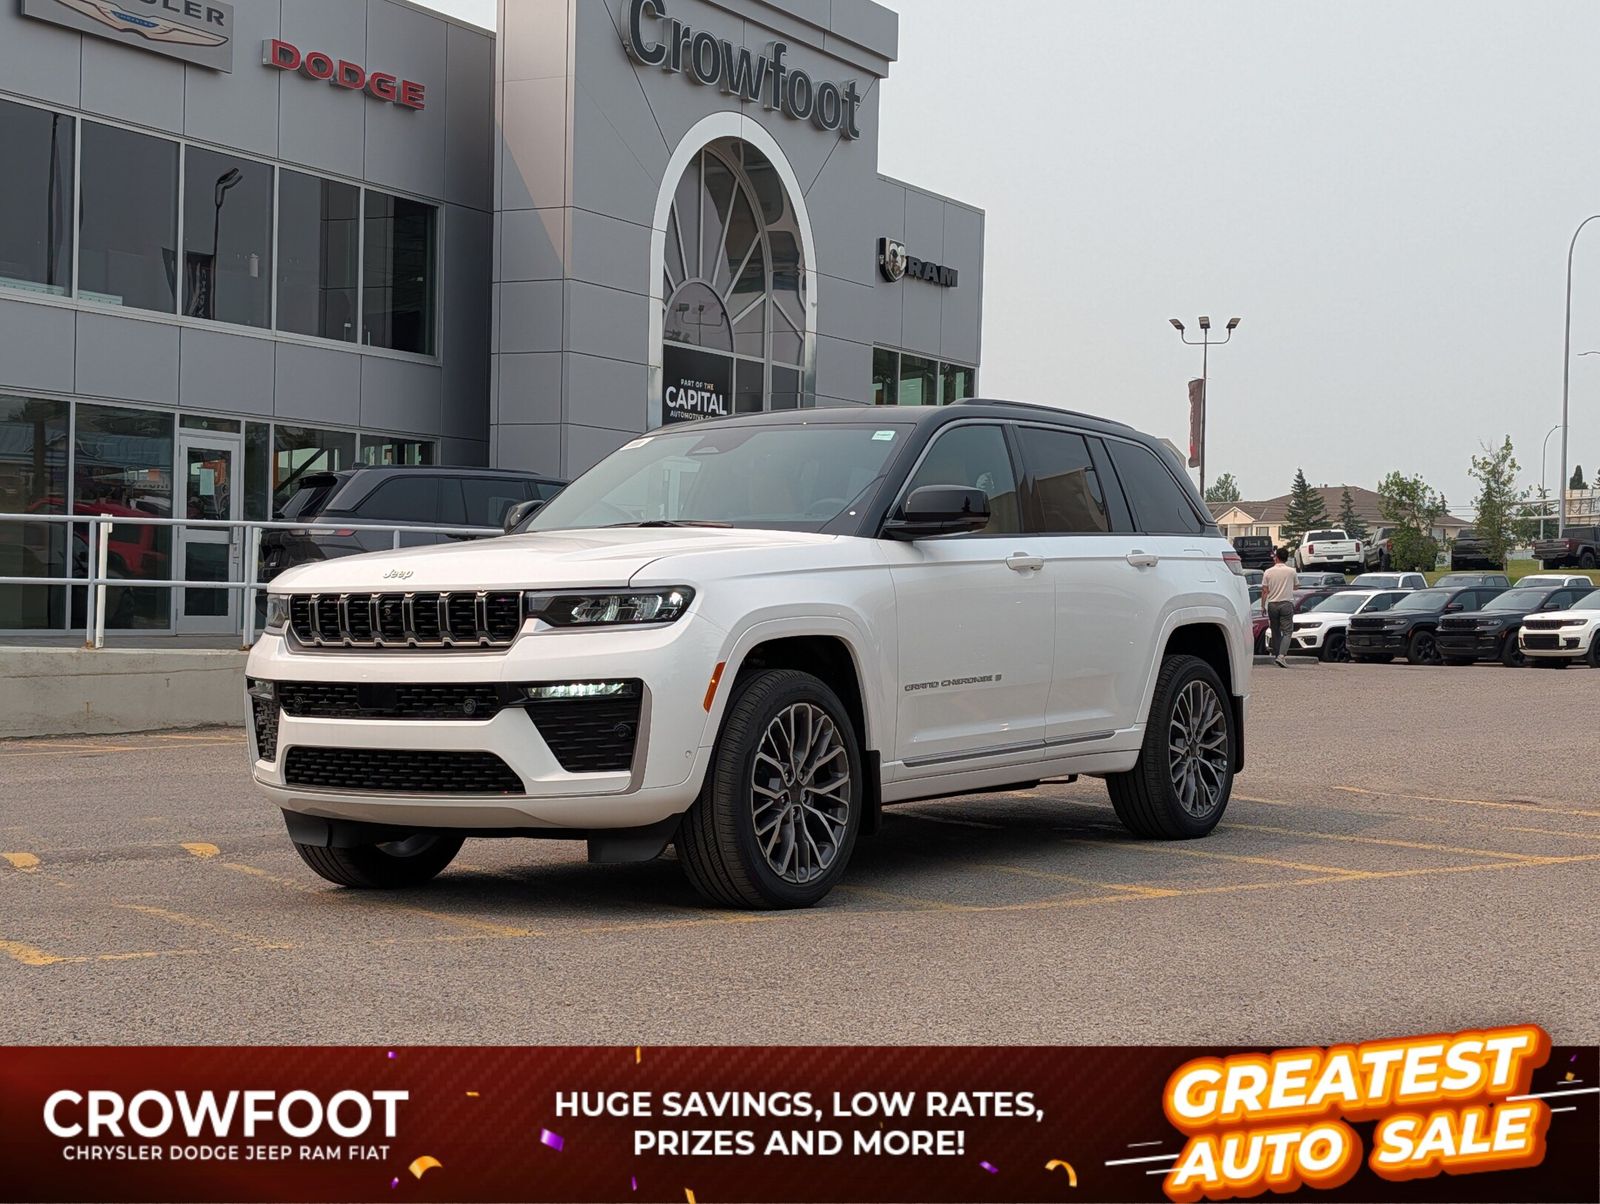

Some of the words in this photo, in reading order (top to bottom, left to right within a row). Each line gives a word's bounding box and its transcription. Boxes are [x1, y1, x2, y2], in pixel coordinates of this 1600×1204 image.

[270, 38, 426, 110] DODGE
[628, 0, 861, 140] Crowfoot
[906, 255, 958, 288] RAM
[680, 379, 695, 388] PART
[704, 383, 714, 391] THE
[665, 386, 727, 415] CAPITAL
[670, 410, 704, 421] AUTOMOTIVE
[383, 569, 414, 580] Jeep
